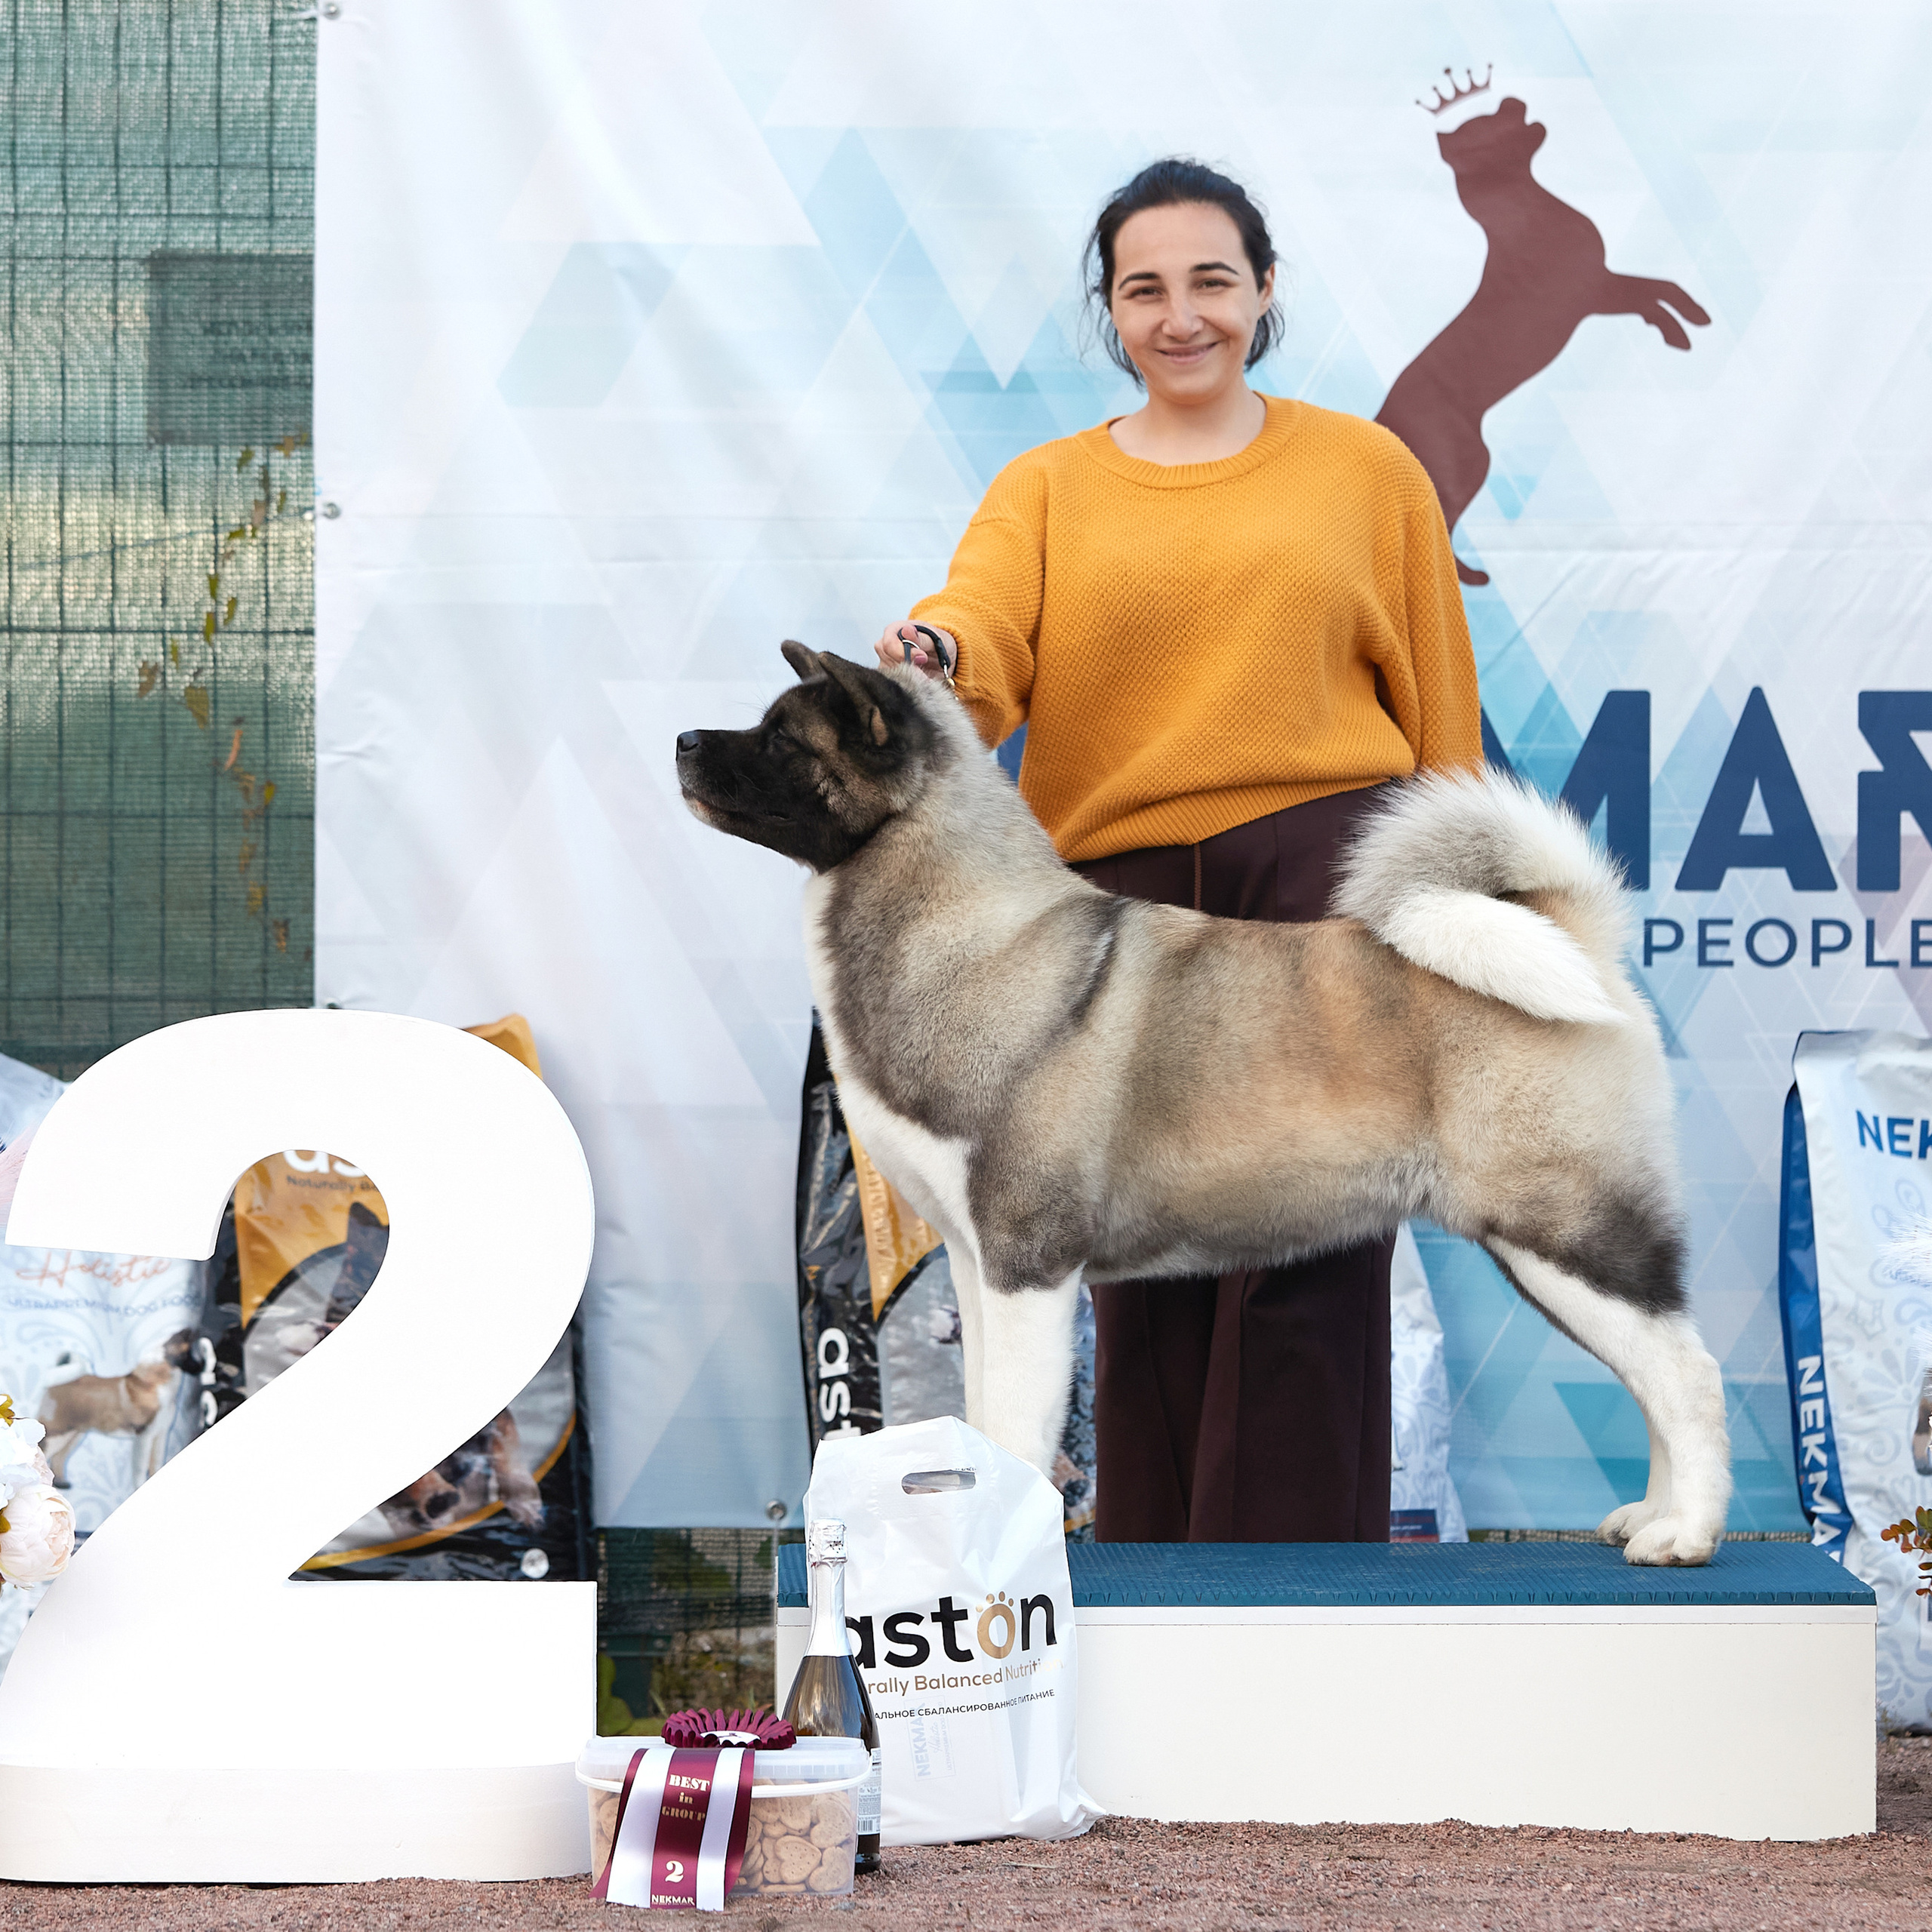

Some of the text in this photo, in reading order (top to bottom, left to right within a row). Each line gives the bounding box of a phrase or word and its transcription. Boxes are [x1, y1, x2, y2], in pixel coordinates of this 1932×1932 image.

[1643, 918, 1932, 968] PEOPLE
[0, 1009, 597, 1774] 2
[1798, 1355, 1842, 1563] NEKMA
[915, 1668, 1003, 1691] Balanced
[1004, 1657, 1064, 1681] Nutrition
[918, 1697, 1017, 1716] СБАЛАНСИРОВАННОЕ
[1017, 1689, 1056, 1704] ПИТАНИЕ
[669, 1774, 710, 1792] BEST
[679, 1792, 694, 1804] in
[661, 1806, 706, 1821] GROUP
[665, 1860, 685, 1884] 2
[651, 1894, 696, 1906] NEKMAR
